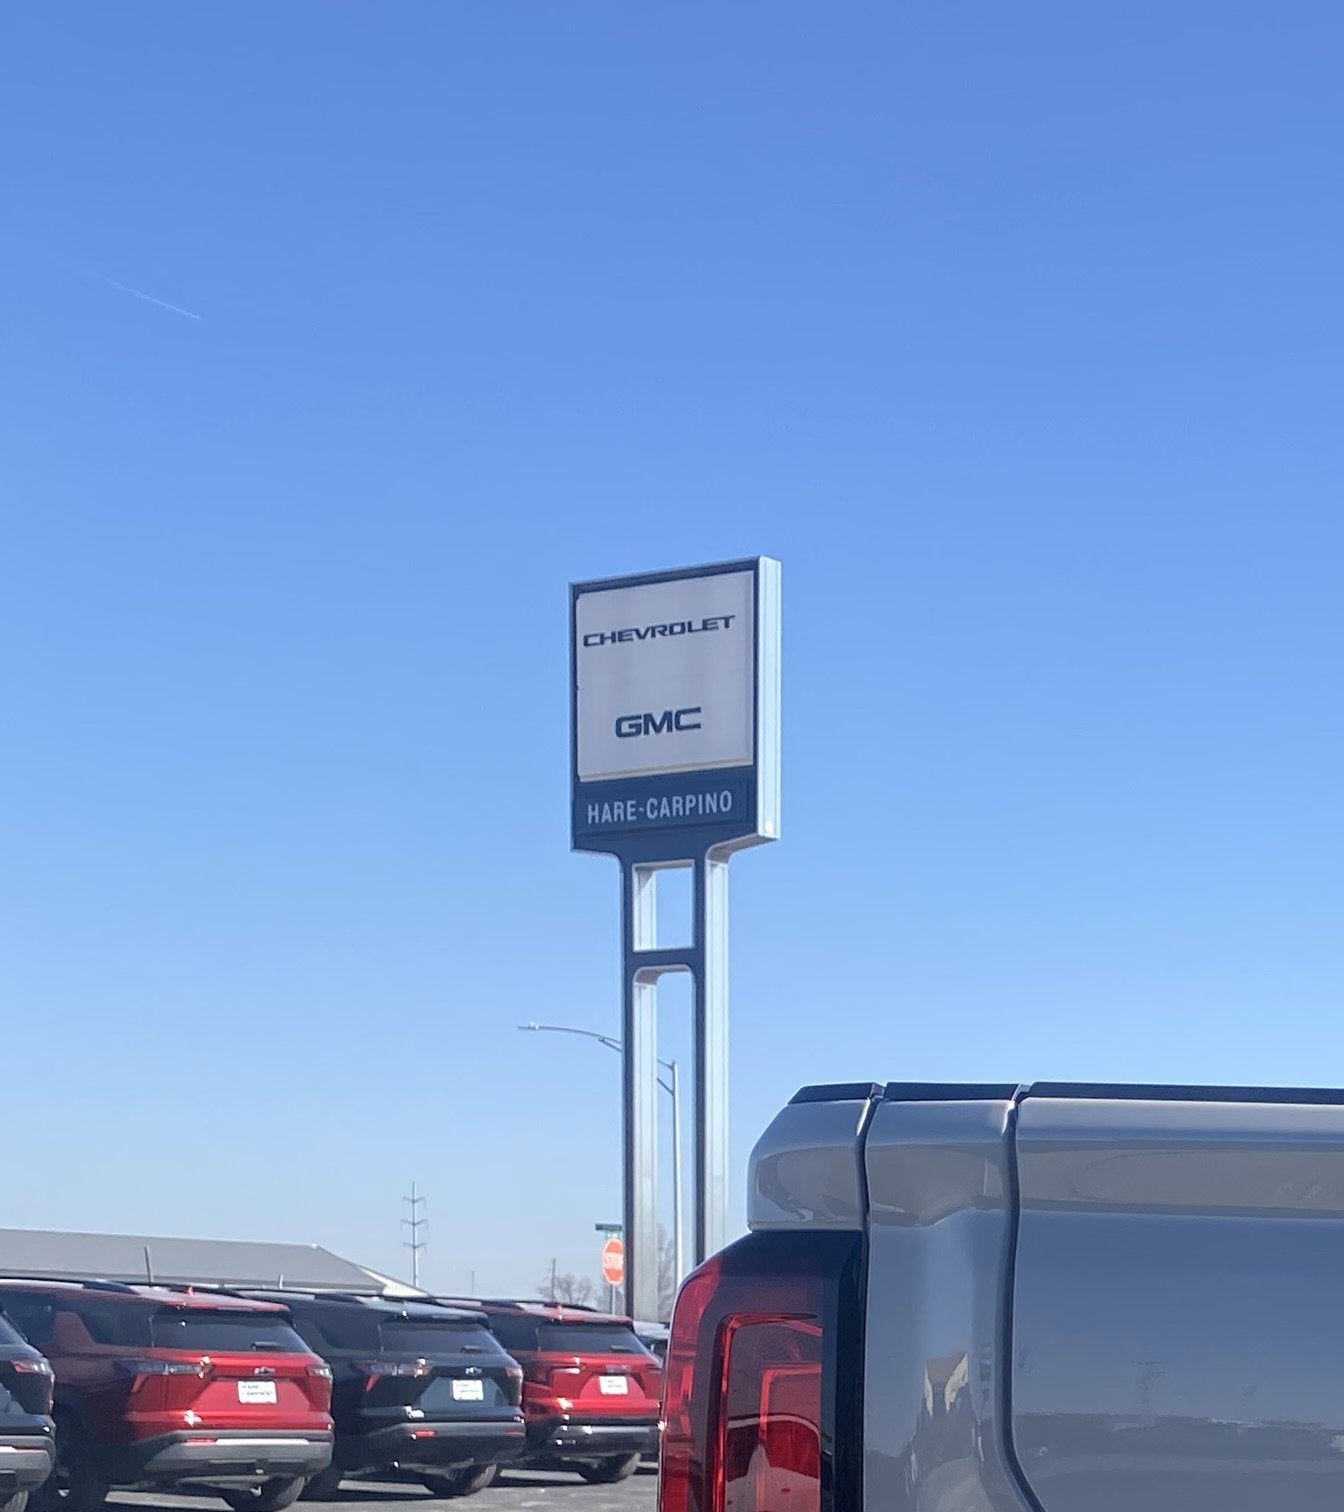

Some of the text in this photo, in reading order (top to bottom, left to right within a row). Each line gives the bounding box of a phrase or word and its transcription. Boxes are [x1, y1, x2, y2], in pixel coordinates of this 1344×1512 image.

[582, 615, 736, 647] CHEVROLET
[614, 706, 702, 739] GMC
[587, 789, 733, 825] HARE-CARPINO
